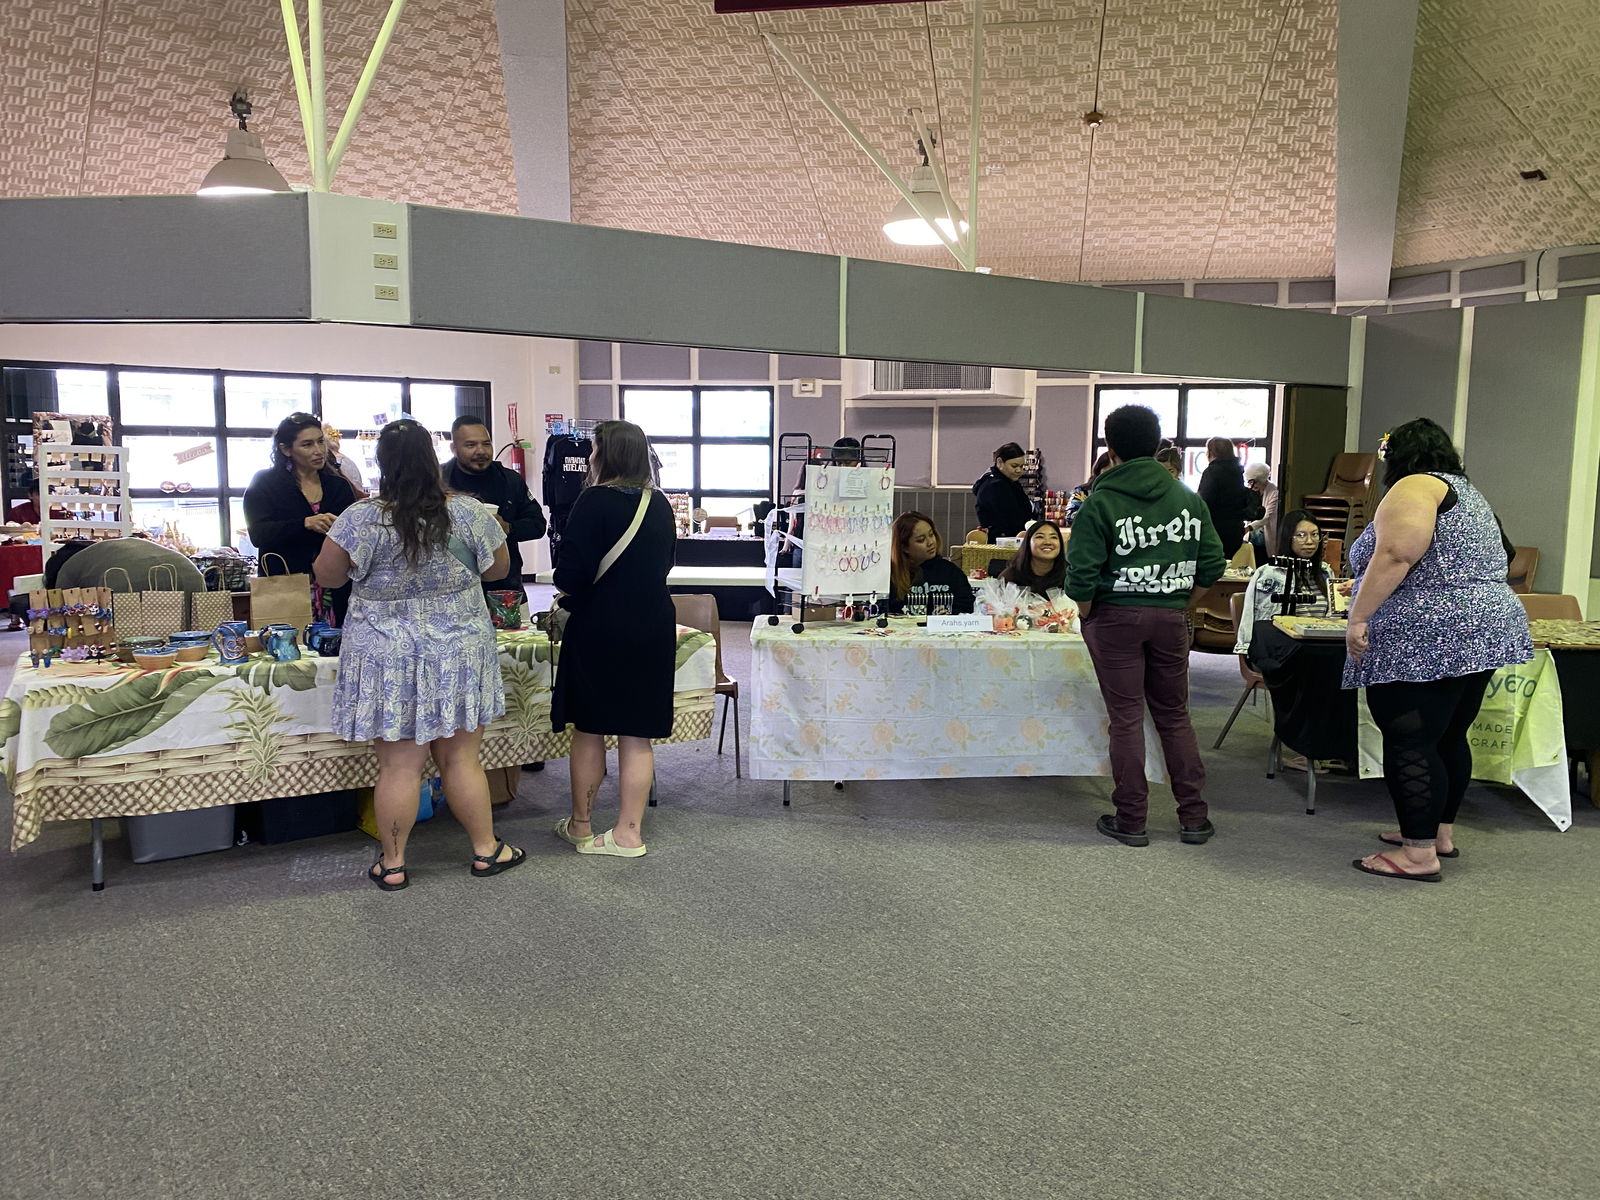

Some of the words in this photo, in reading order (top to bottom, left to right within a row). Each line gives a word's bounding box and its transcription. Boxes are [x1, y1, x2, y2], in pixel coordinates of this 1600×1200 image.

[1115, 508, 1202, 556] Jireh
[1112, 564, 1160, 582] YOU
[1162, 560, 1197, 578] ARE
[923, 582, 950, 594] love
[1112, 576, 1194, 593] ENOUGH
[964, 620, 979, 628] yarn
